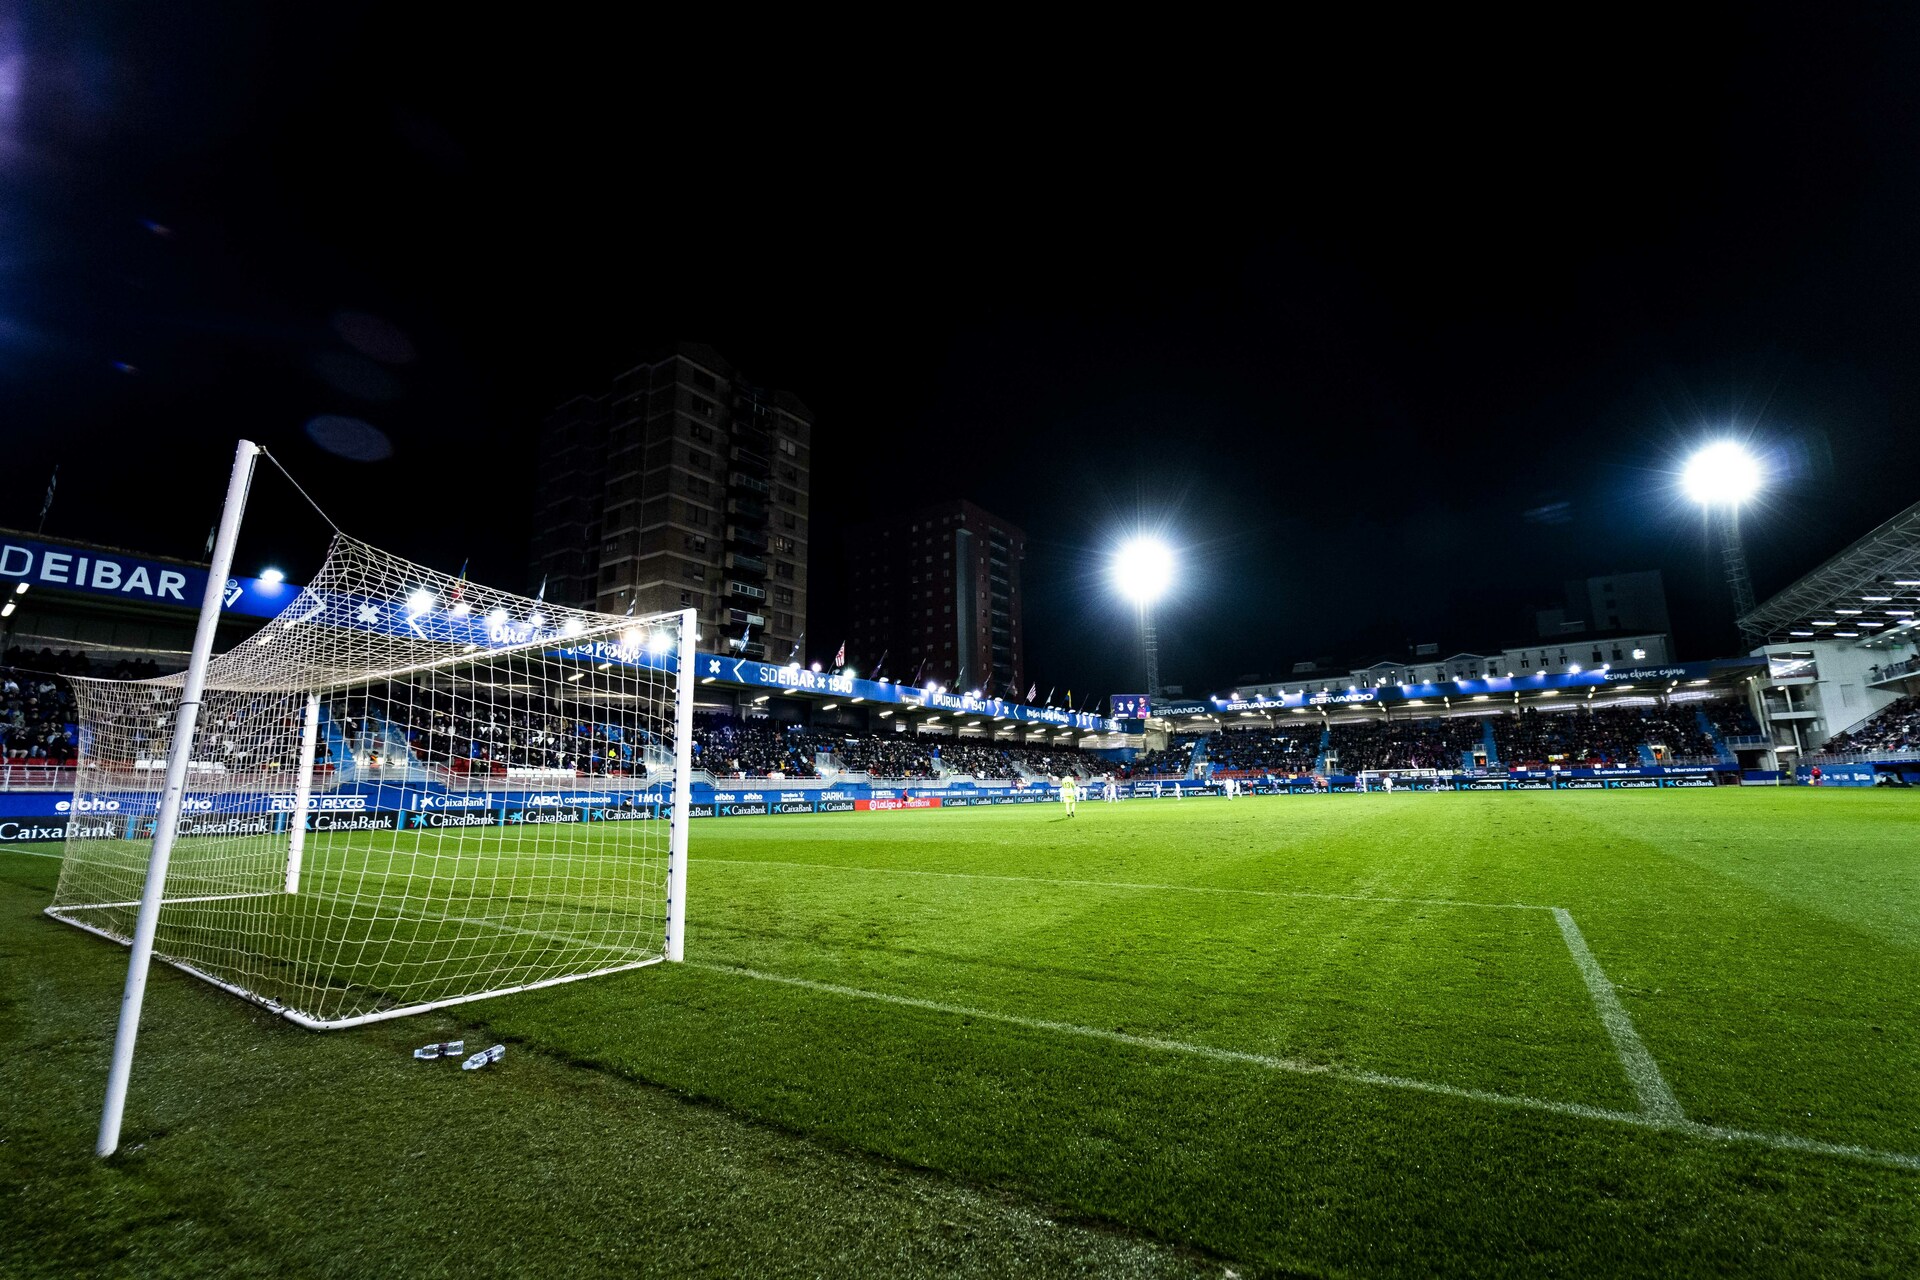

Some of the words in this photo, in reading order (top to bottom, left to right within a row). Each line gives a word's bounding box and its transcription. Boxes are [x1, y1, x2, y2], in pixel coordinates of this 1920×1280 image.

[828, 677, 853, 694] 1940
[932, 692, 962, 709] IPURUA
[1309, 693, 1374, 705] SERVANDO
[1152, 706, 1205, 716] SERVANDO
[1226, 700, 1285, 711] SERVANDO
[271, 798, 317, 809] ALYO
[321, 798, 365, 809] ALYCO
[435, 797, 484, 807] CaixaBank
[638, 793, 663, 804] IMQ
[731, 804, 766, 815] CaixaBank
[782, 803, 813, 813] CaixaBank
[827, 802, 854, 811] CaixaBank
[877, 800, 896, 810] LaLiga
[526, 810, 579, 822] CaixaBank
[606, 808, 651, 820] CaixaBank
[315, 815, 392, 830] CaixaBank
[430, 813, 494, 827] CaixaBank
[0, 822, 116, 840] CaixaBank
[179, 818, 268, 834] CaixaBank
